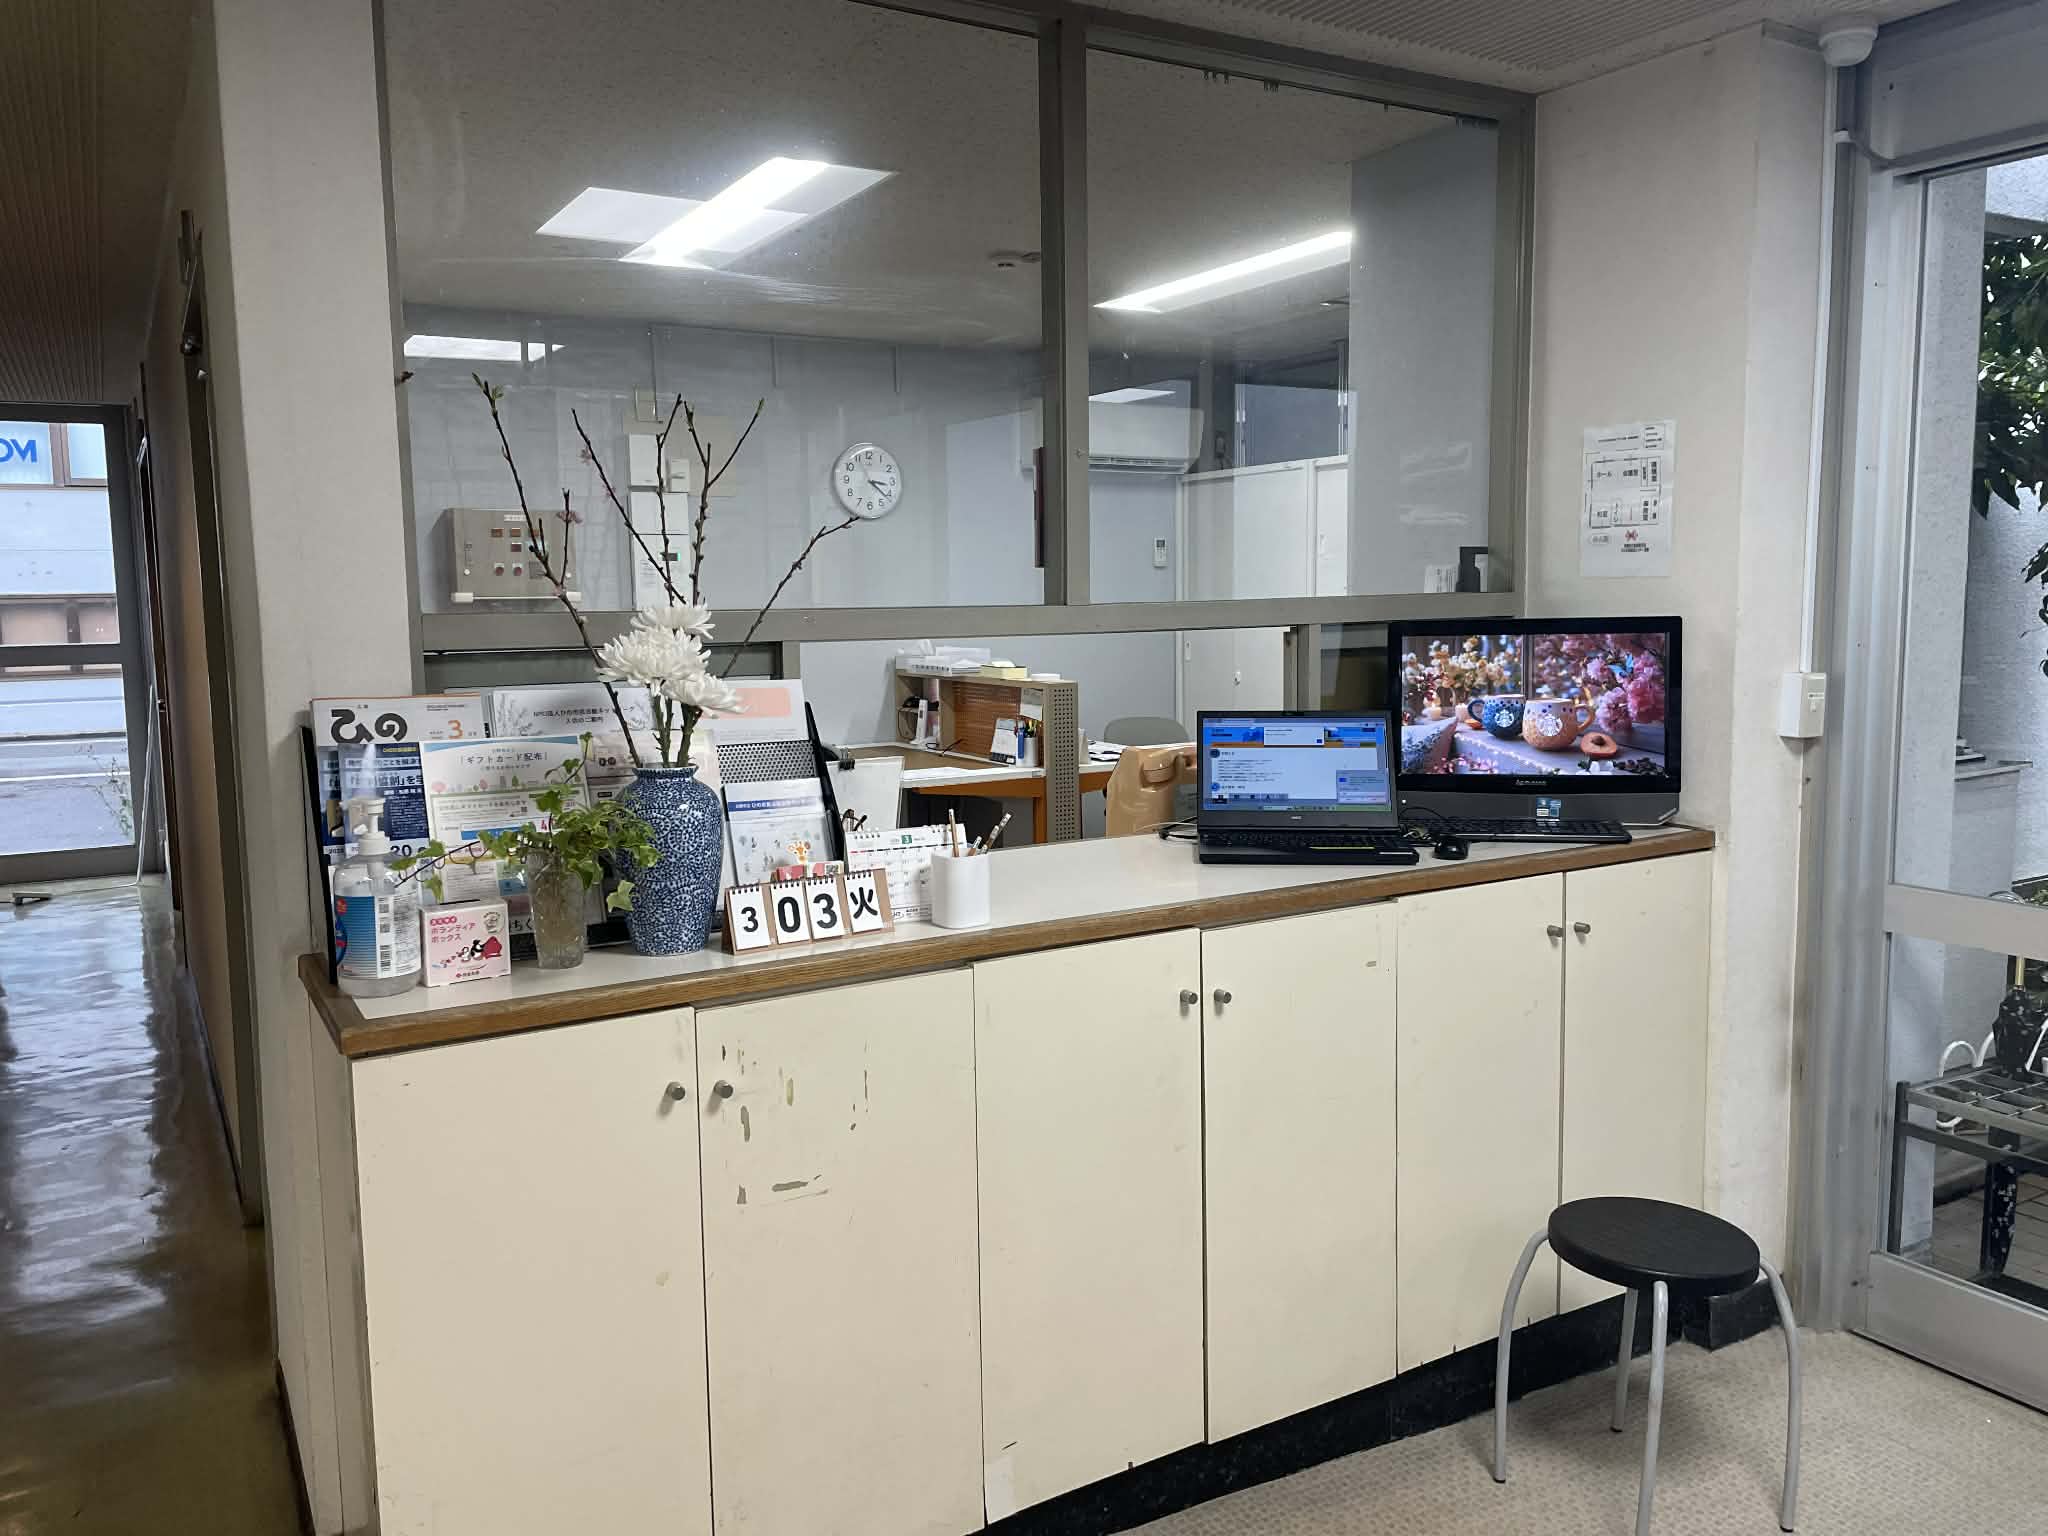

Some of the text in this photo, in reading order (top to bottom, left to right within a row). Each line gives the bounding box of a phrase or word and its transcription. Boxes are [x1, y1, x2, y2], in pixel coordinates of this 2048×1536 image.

[855, 455, 861, 463] 11
[865, 451, 873, 460] 12
[846, 462, 854, 472] 10
[886, 464, 892, 473] 2
[843, 475, 850, 484] 9
[889, 476, 896, 486] 3
[848, 488, 854, 497] 8
[856, 497, 863, 506] 7
[866, 501, 873, 511] 6
[448, 719, 464, 740] 3
[741, 906, 759, 933] 3
[850, 886, 878, 919] 火
[431, 933, 462, 944] ボックス
